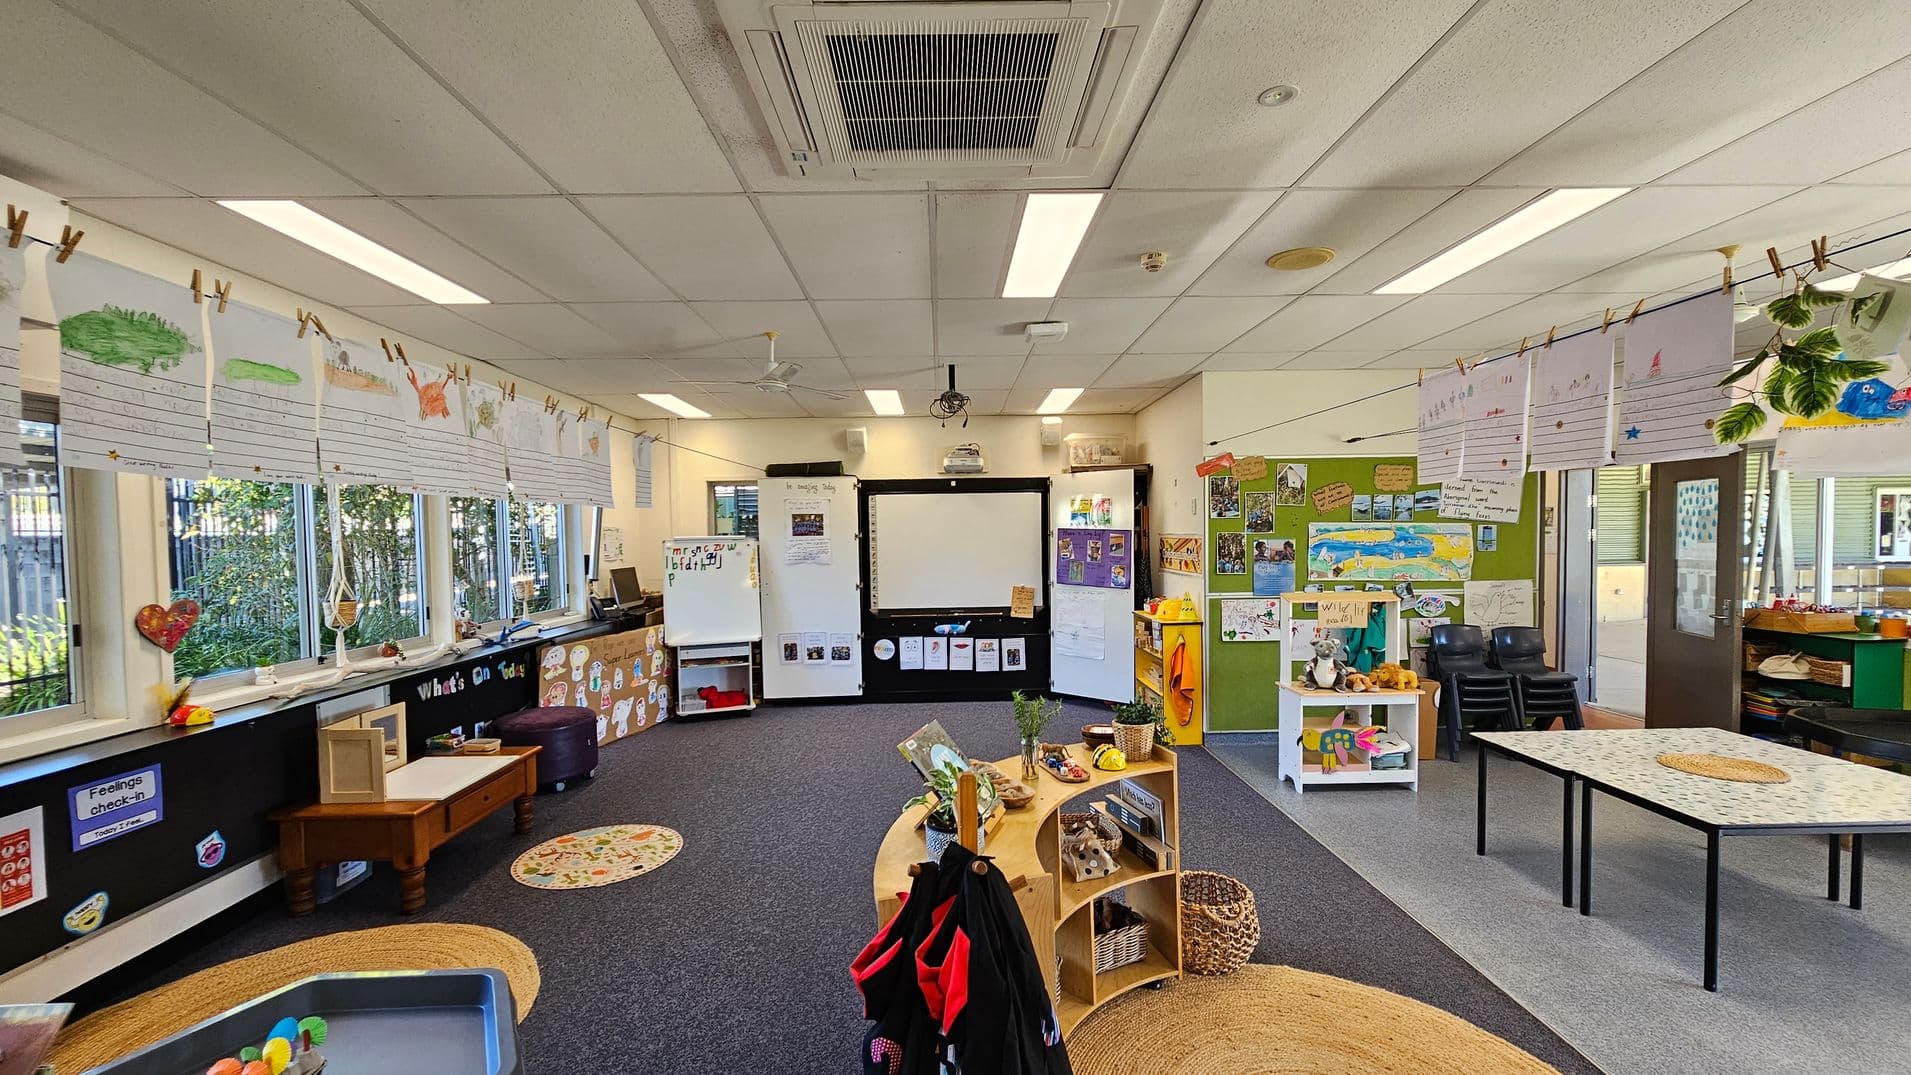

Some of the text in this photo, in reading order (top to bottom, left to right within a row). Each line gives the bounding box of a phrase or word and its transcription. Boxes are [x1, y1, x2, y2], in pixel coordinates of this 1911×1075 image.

[1471, 484, 1484, 493] from
[417, 671, 465, 701] What's
[472, 666, 491, 686] On
[89, 776, 143, 800] Feelings
[90, 791, 145, 815] check-in
[94, 825, 118, 839] Today
